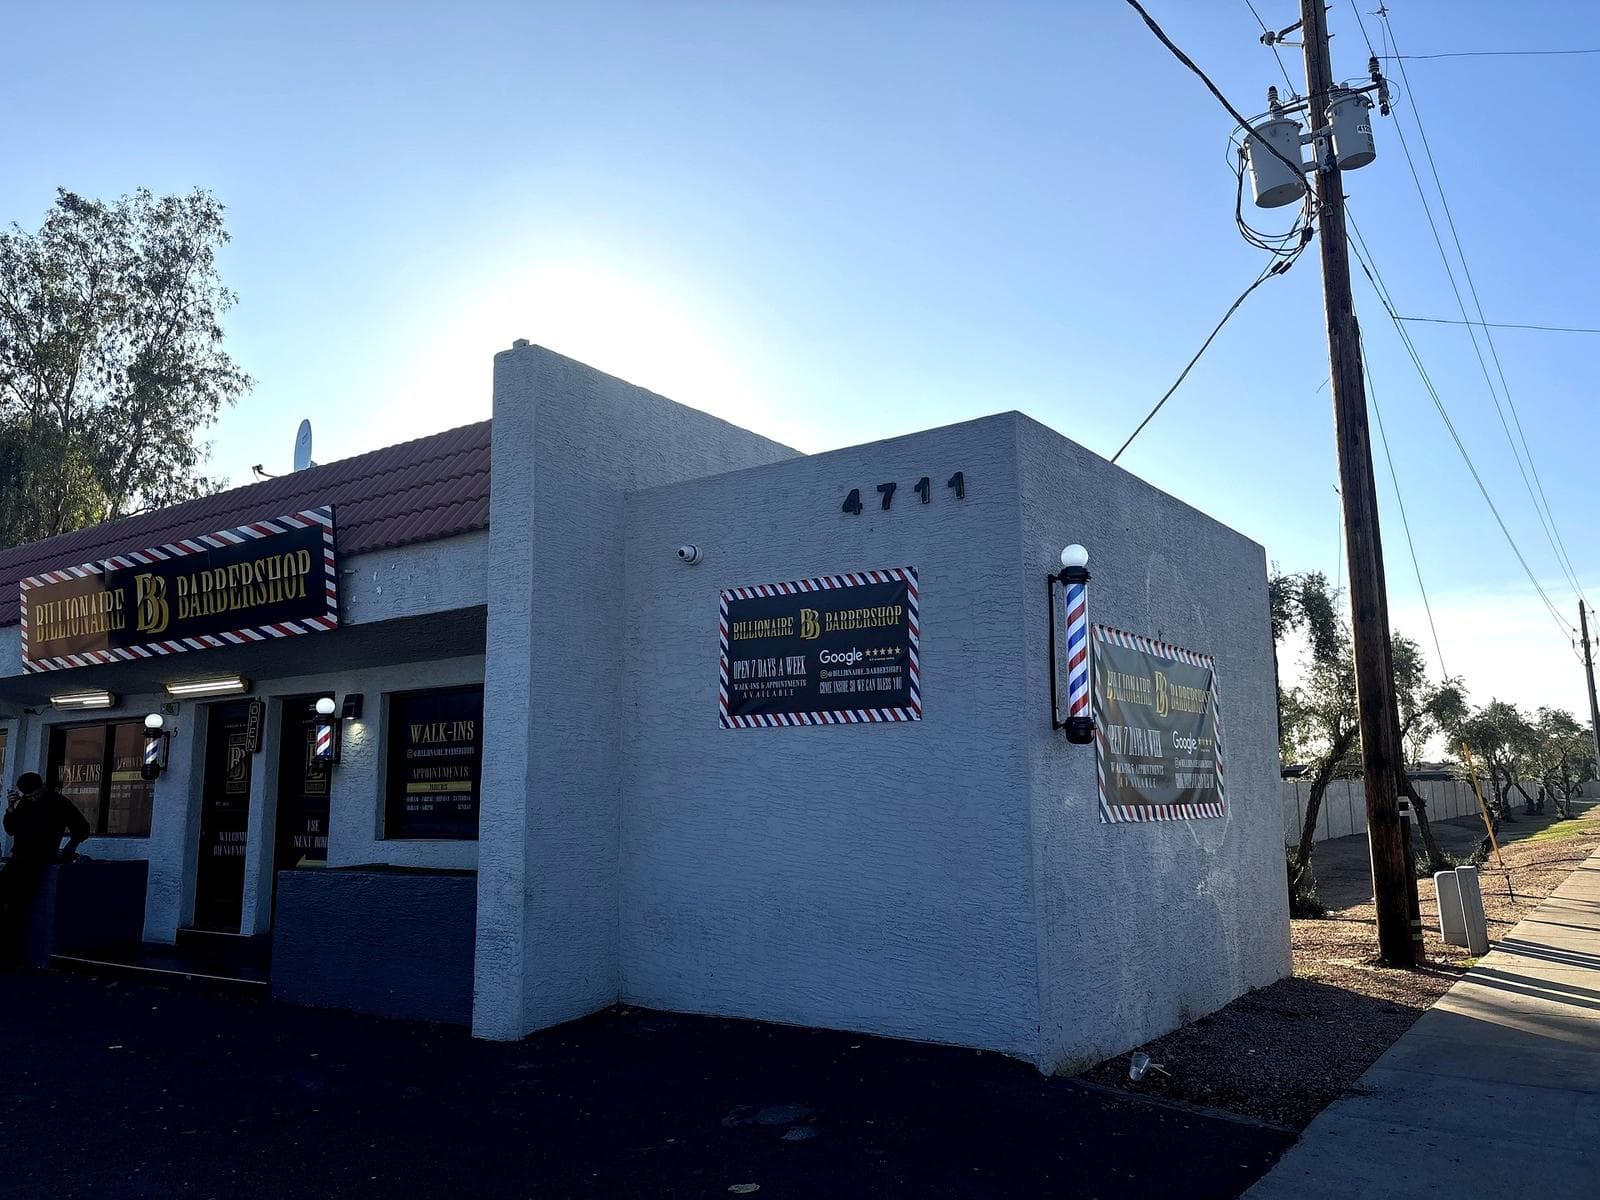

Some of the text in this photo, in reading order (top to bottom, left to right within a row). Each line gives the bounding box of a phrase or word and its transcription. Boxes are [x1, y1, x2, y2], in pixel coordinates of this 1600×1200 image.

[842, 472, 965, 515] 4711
[36, 588, 126, 643] BILLIONAIRE
[176, 549, 311, 620] BARBERSHOP
[732, 616, 794, 641] BILLIONAIRE
[824, 605, 902, 632] BARBERSHOP
[733, 655, 807, 680] OPEN 7 DAYS A WEEK
[819, 647, 863, 666] Google
[733, 682, 760, 691] WALK-INS
[765, 679, 807, 689] APPOINTMENTS
[742, 688, 795, 699] AVAILABLE
[1106, 670, 1152, 706] BILLIONAIRE
[247, 704, 260, 750] OPEN
[410, 719, 475, 744] WALK-INS
[1172, 730, 1198, 755] Google
[58, 764, 102, 782] WALK-INS
